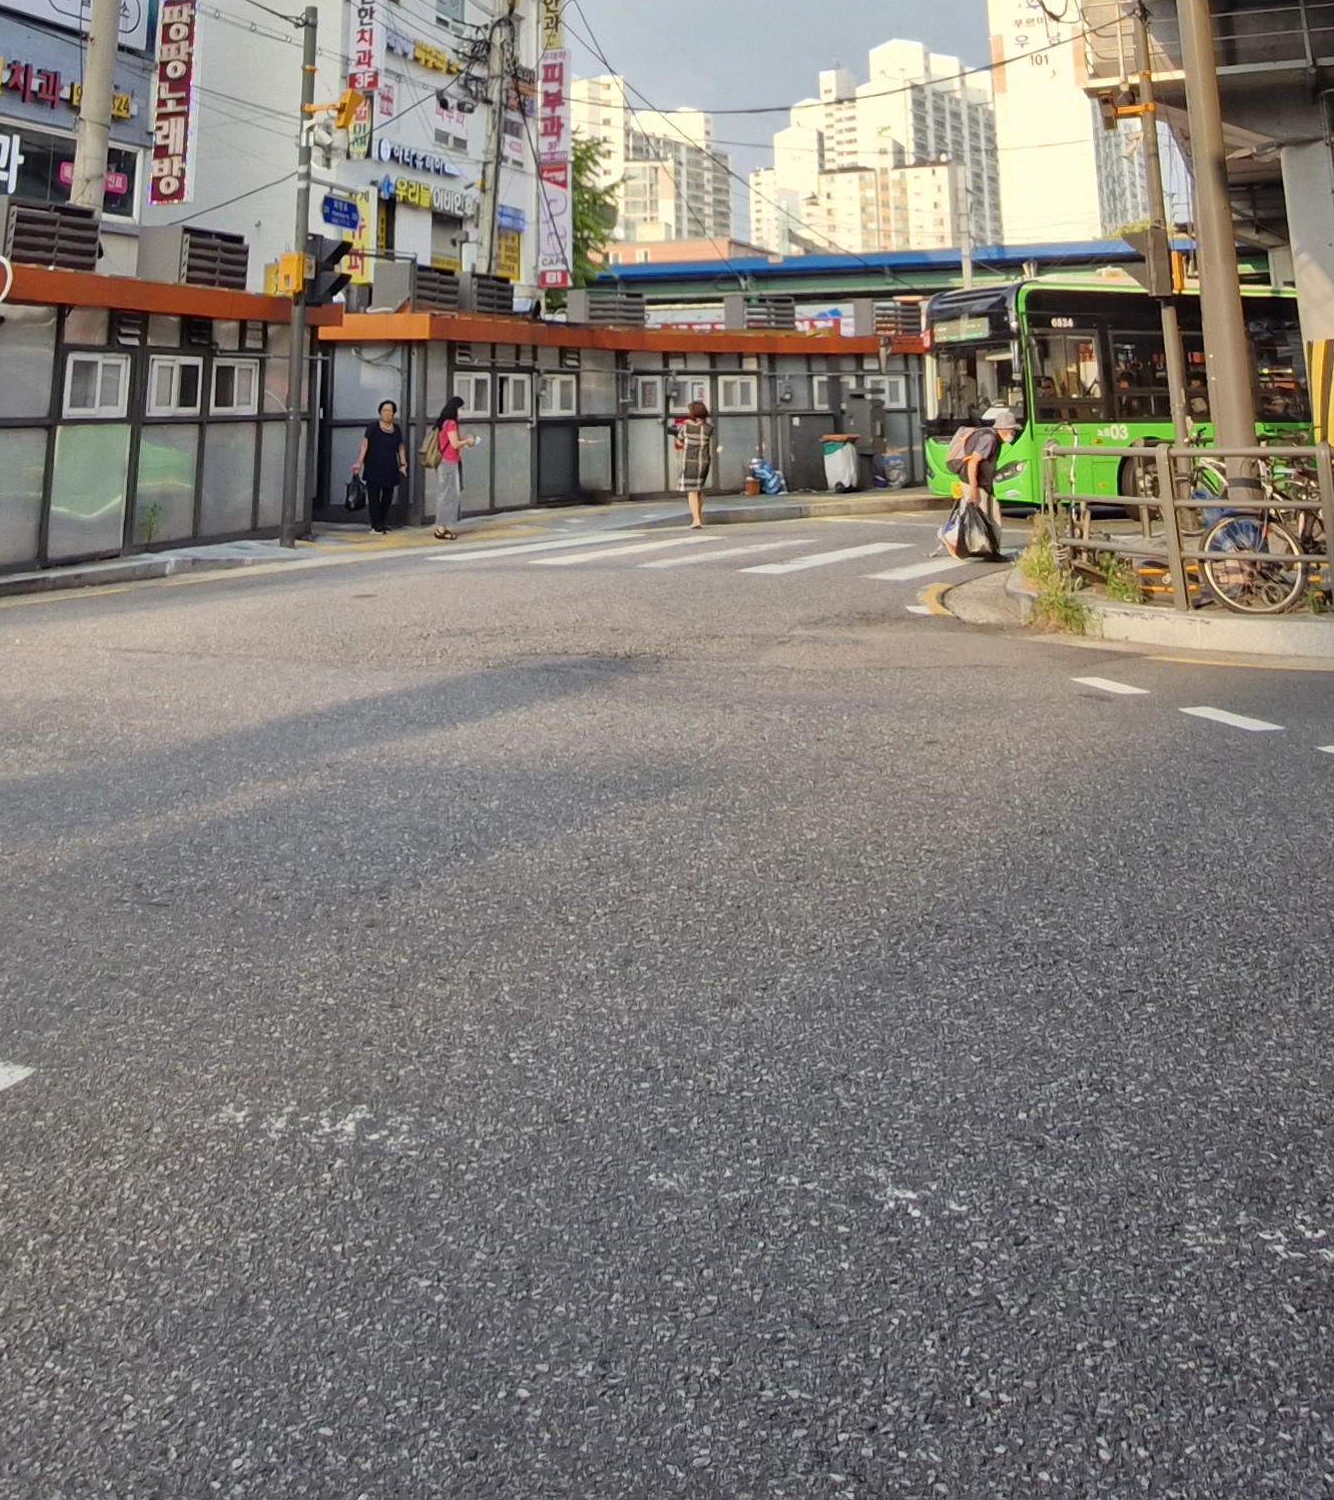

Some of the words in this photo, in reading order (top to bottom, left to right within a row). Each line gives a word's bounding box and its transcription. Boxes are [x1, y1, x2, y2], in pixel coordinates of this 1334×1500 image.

[1030, 54, 1049, 67] 101
[354, 72, 374, 88] 3F
[540, 62, 565, 143] 피부과
[396, 177, 432, 209] 우리들
[432, 186, 480, 218] 이비인후
